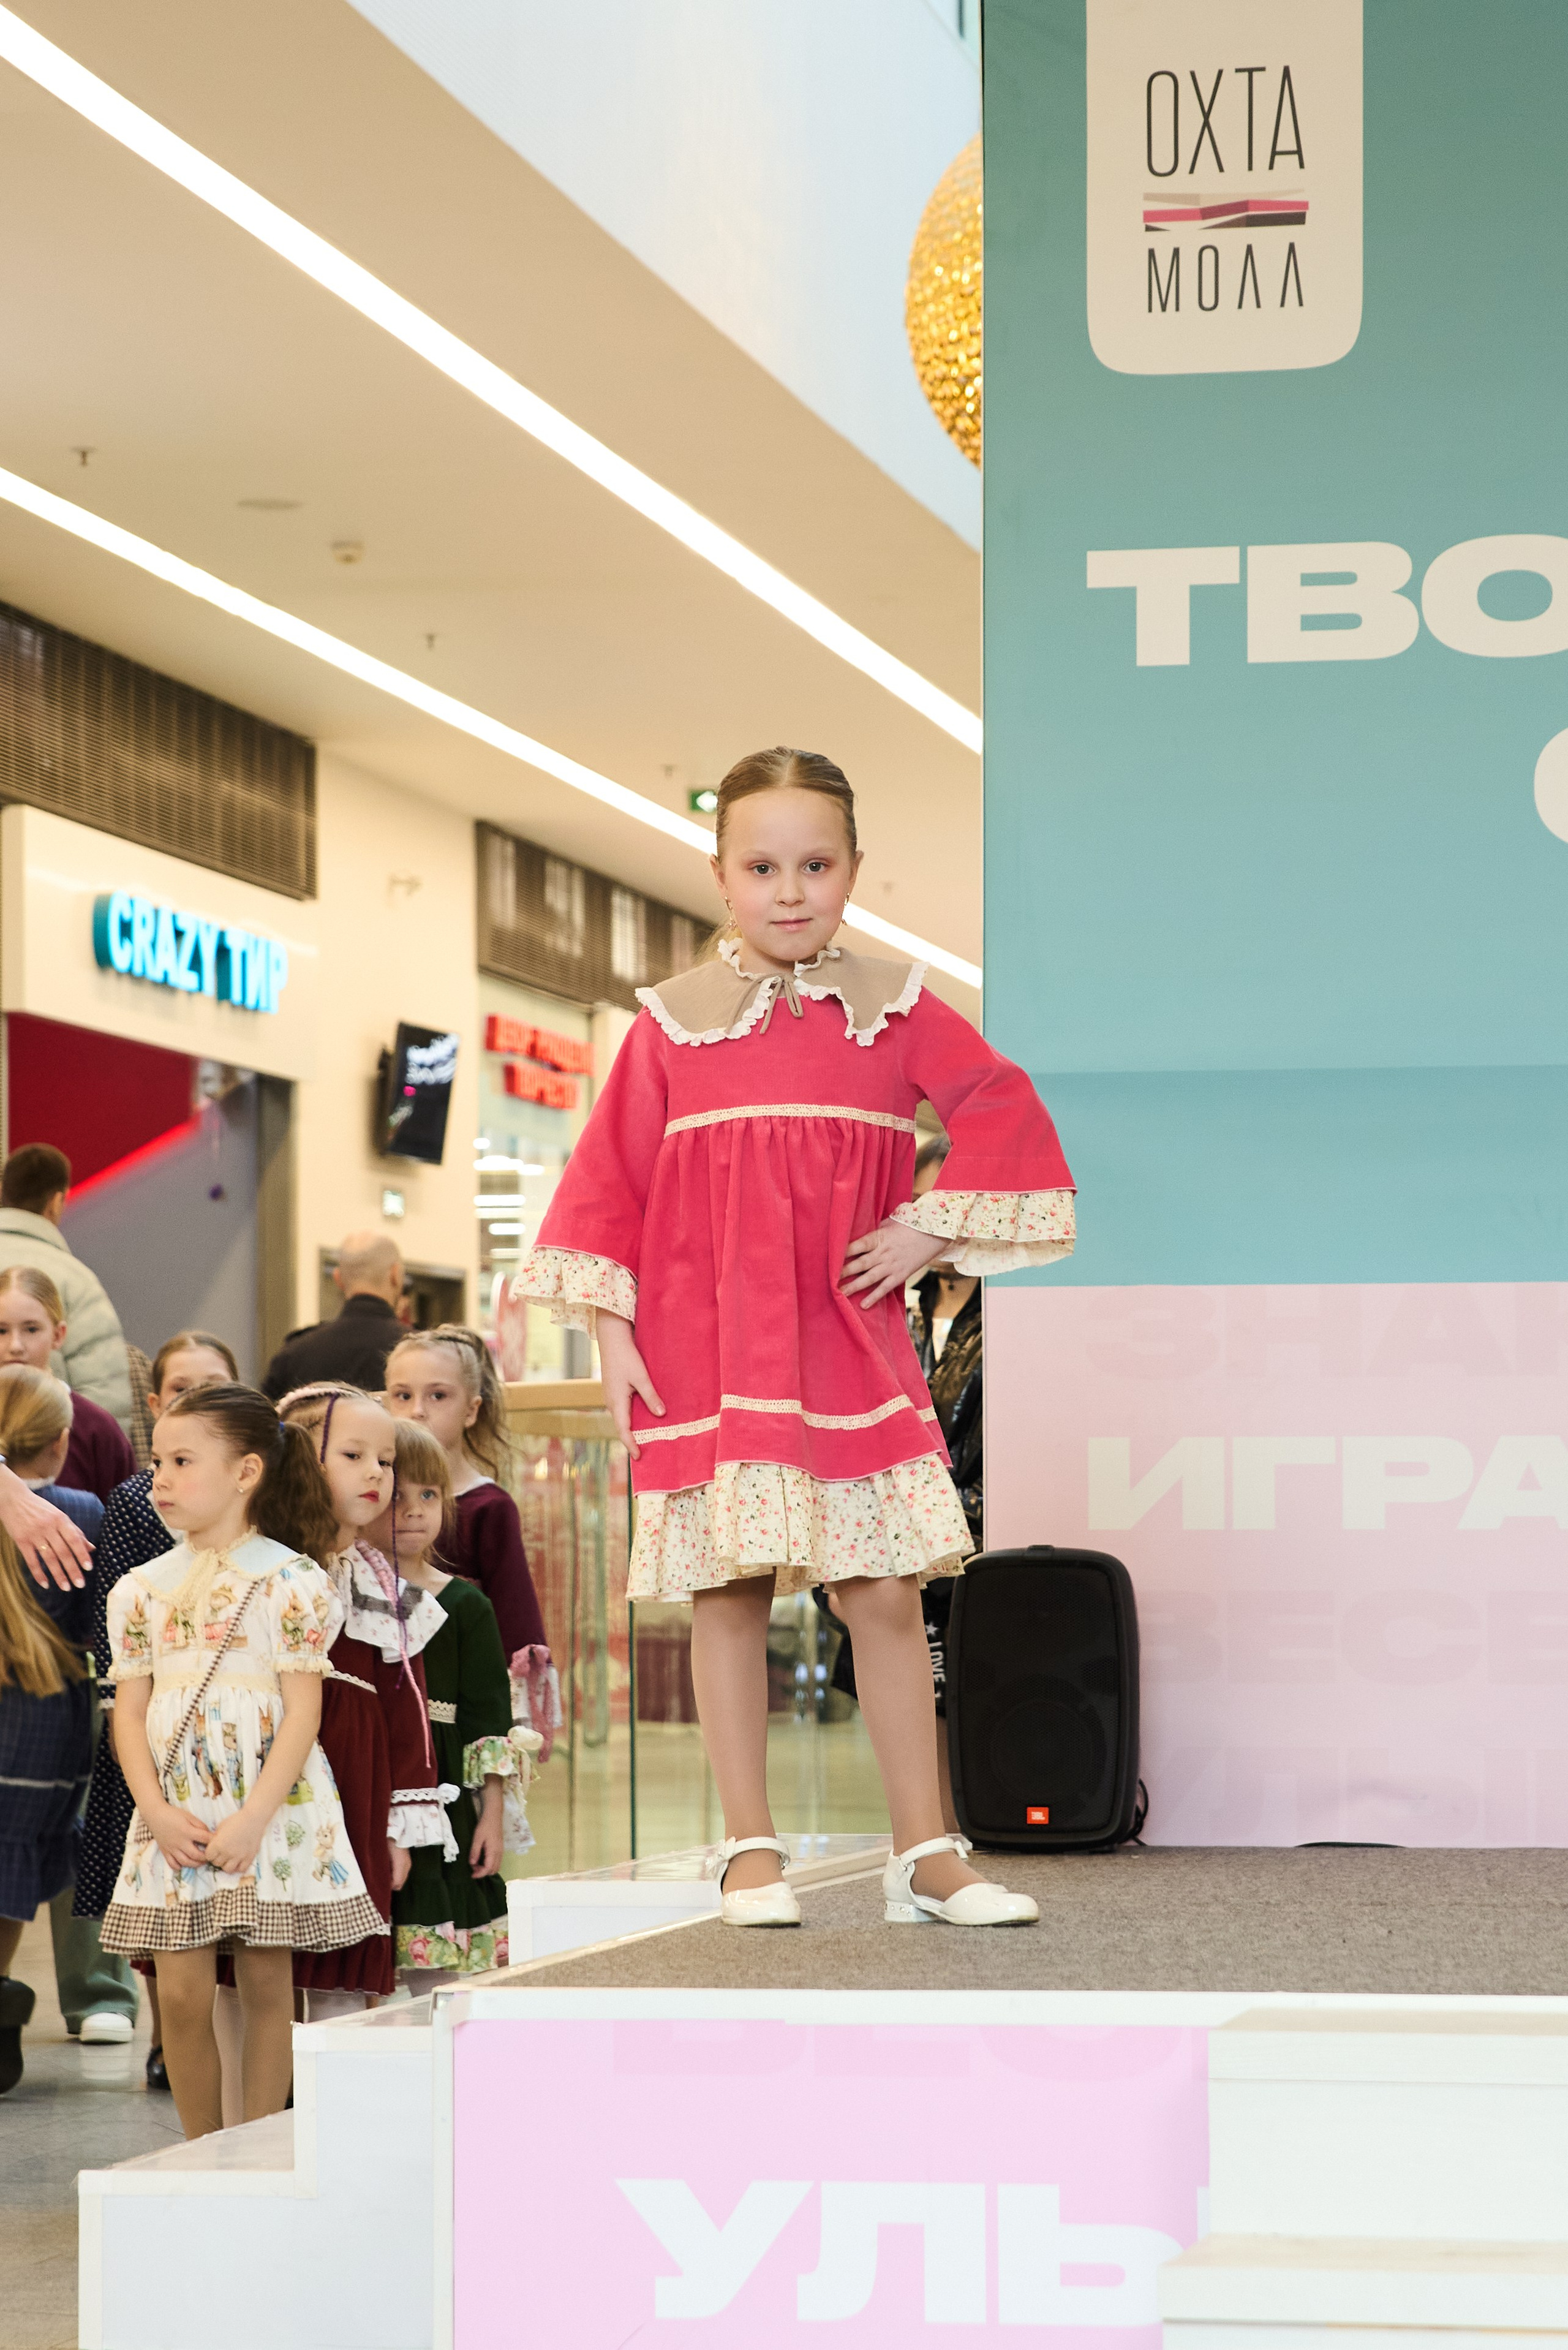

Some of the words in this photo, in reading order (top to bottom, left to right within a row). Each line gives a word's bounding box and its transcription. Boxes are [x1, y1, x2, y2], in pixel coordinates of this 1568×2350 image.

[1146, 65, 1305, 177] ОХТА
[1147, 241, 1304, 313] МОЛЛ
[1087, 534, 1568, 667] ТВО
[104, 890, 219, 997] CRAZY
[223, 926, 288, 1014] ТИР
[1087, 1435, 1568, 1530] ИГРА
